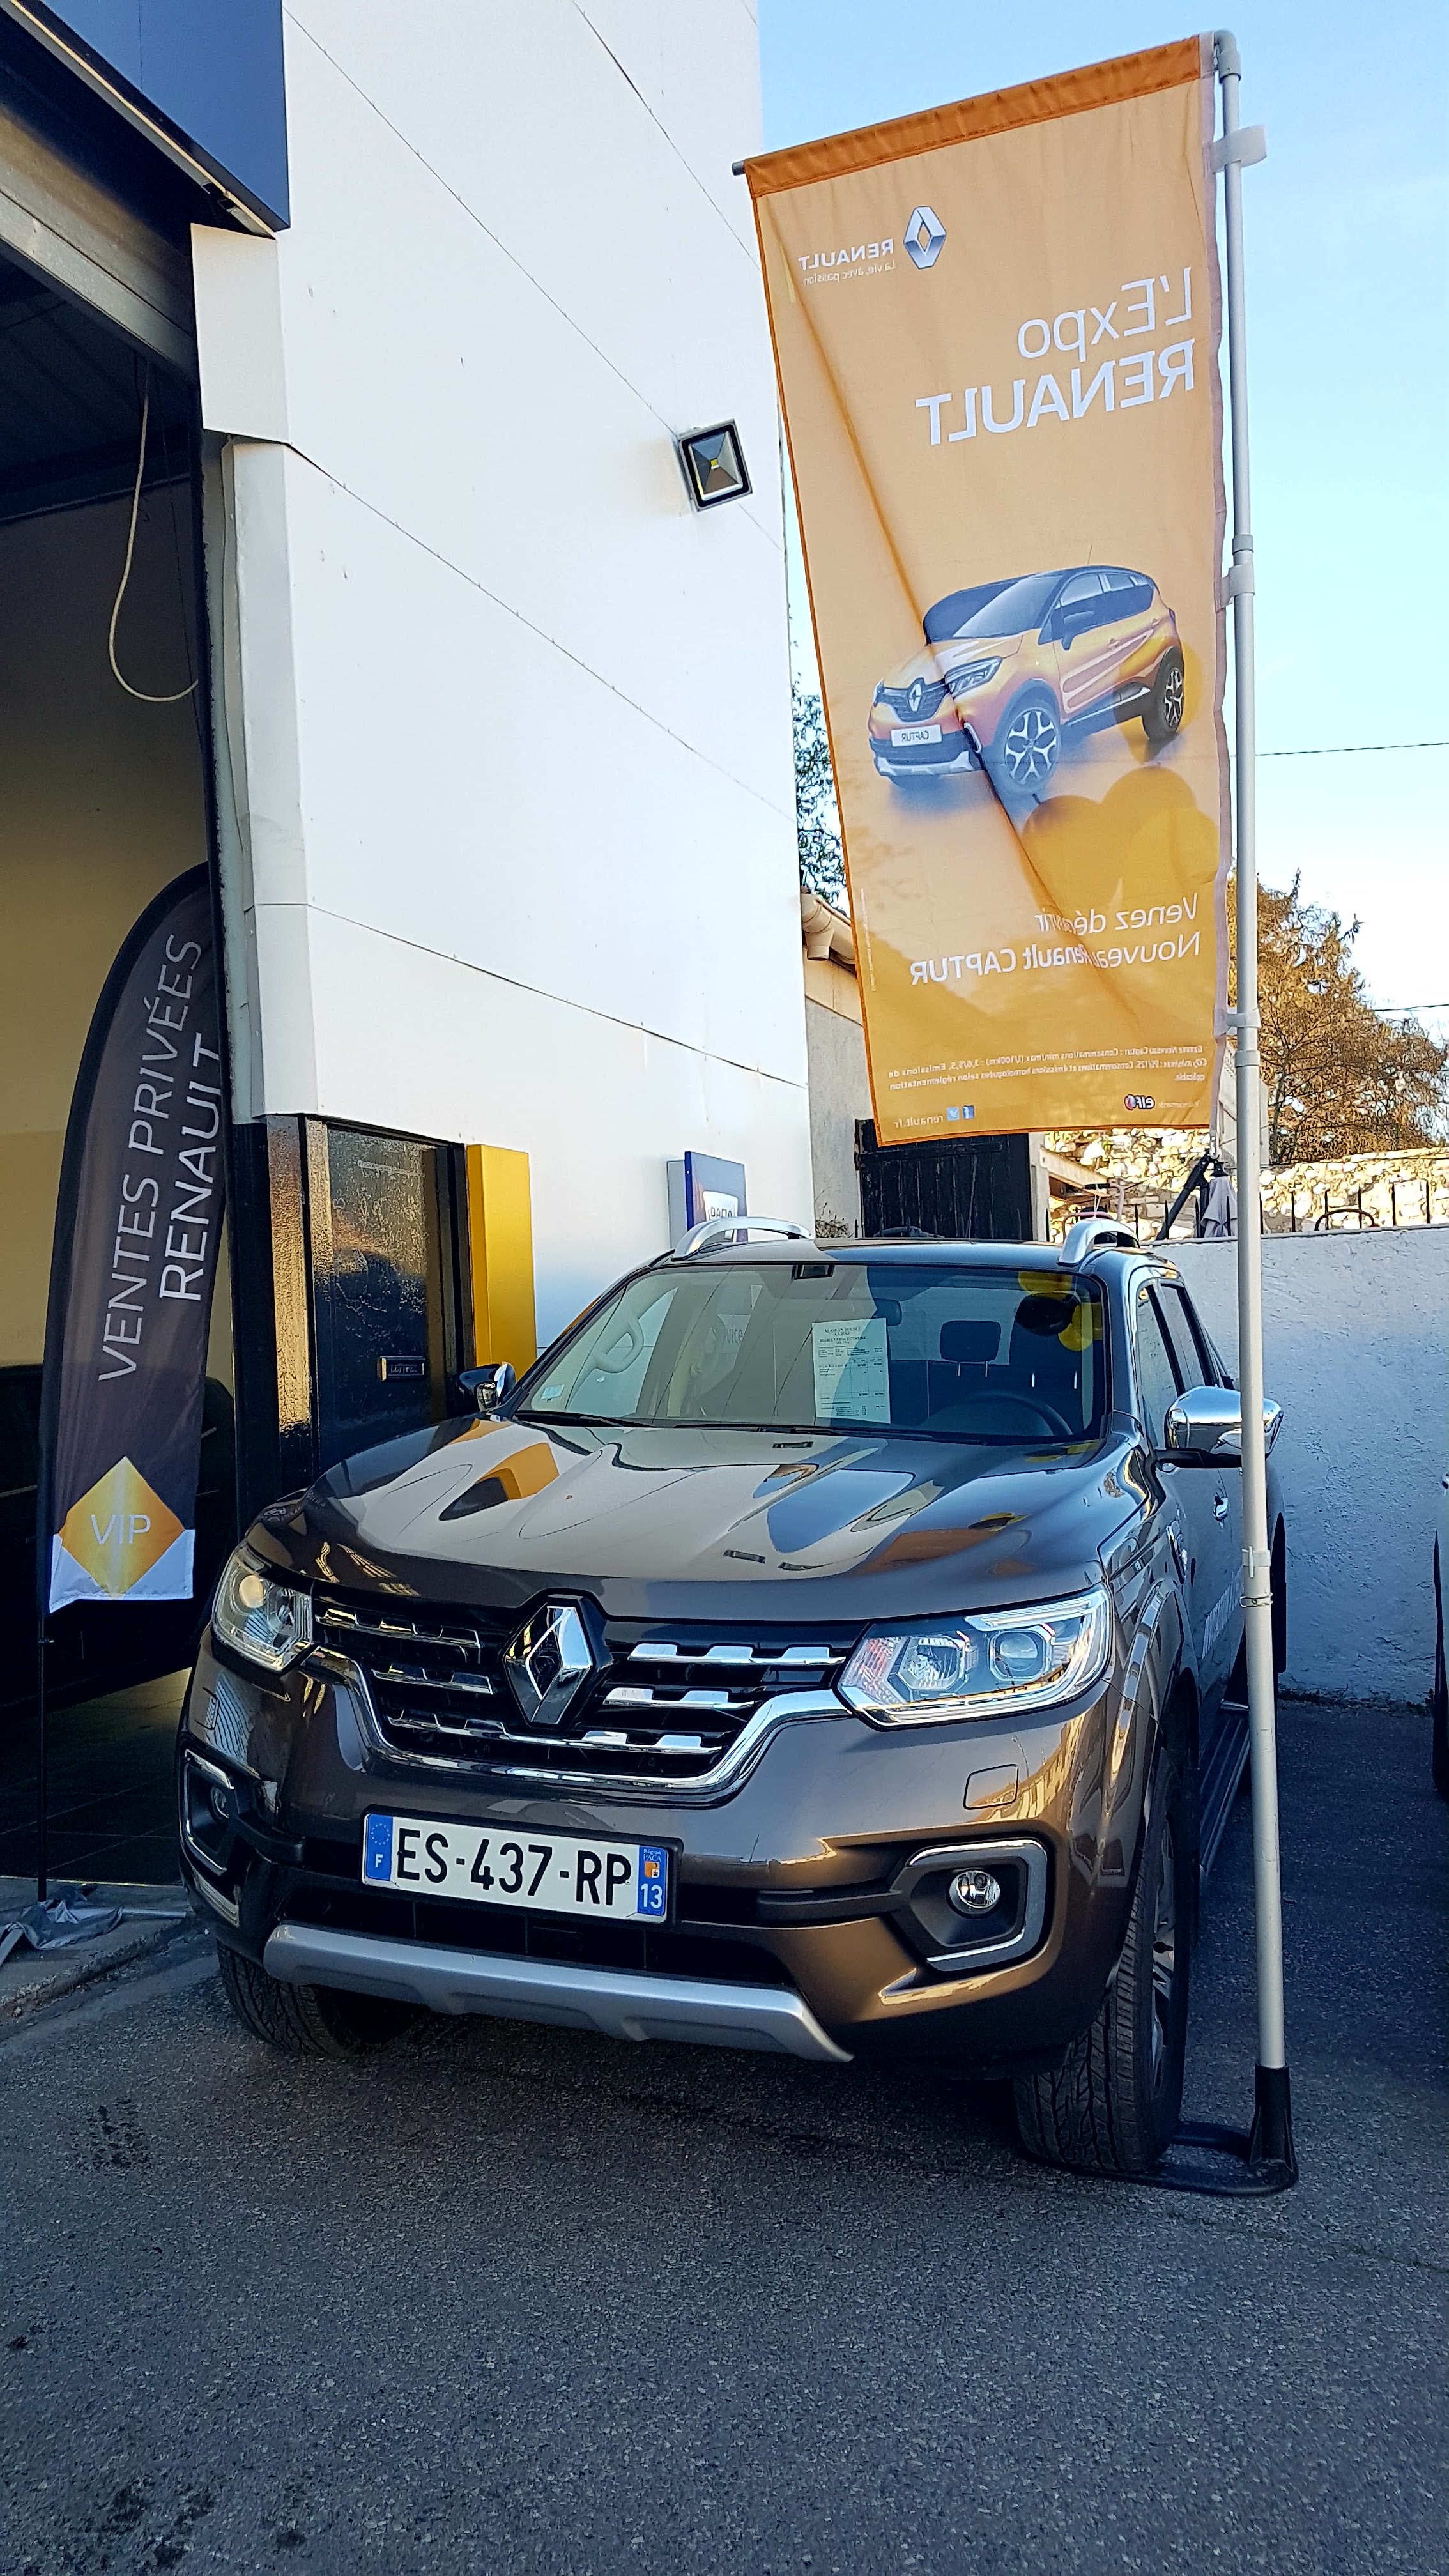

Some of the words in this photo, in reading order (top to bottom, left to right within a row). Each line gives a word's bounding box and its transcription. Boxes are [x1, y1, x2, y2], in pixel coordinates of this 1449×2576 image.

[128, 933, 202, 1154] PRIVÉES
[98, 1174, 160, 1381] VENTES
[91, 1514, 151, 1544] VIP
[374, 1853, 383, 1868] F
[397, 1828, 632, 1906] ES-437-RP
[641, 1883, 663, 1909] 13
